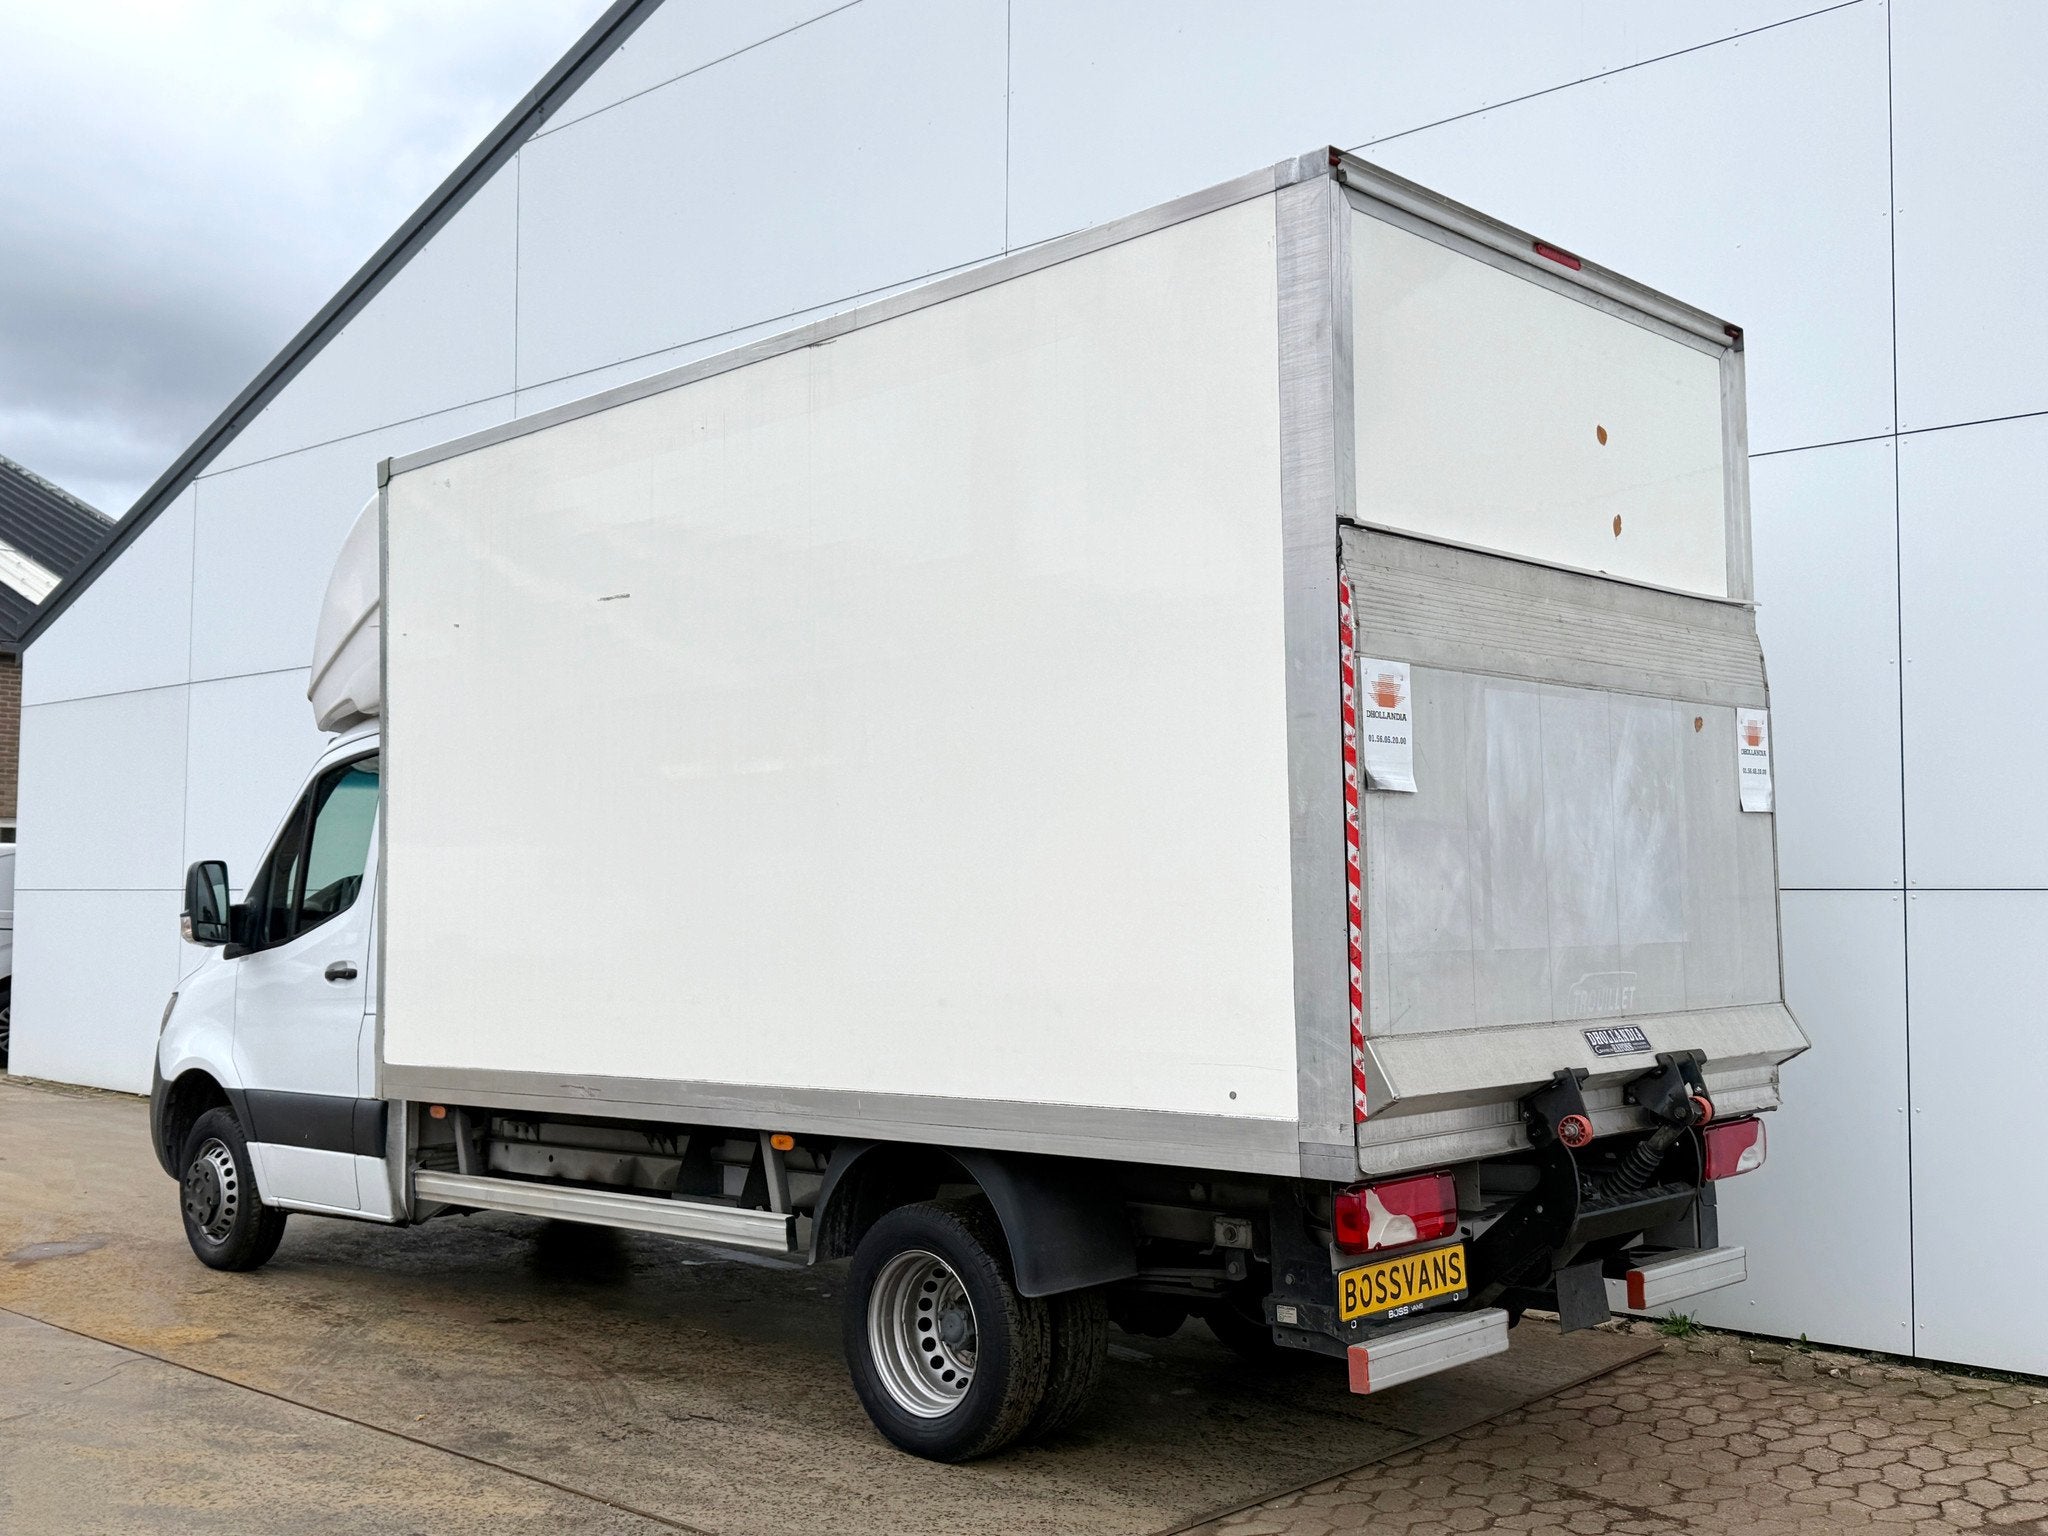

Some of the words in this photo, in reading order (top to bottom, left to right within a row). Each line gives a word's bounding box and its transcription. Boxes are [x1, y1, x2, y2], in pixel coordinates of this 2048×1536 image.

[1366, 709, 1407, 722] DHOLLANDIA
[1585, 1027, 1645, 1046] DHOLLANDIA
[1345, 1252, 1462, 1313] BOSSVANS
[1388, 1305, 1409, 1319] BOSS
